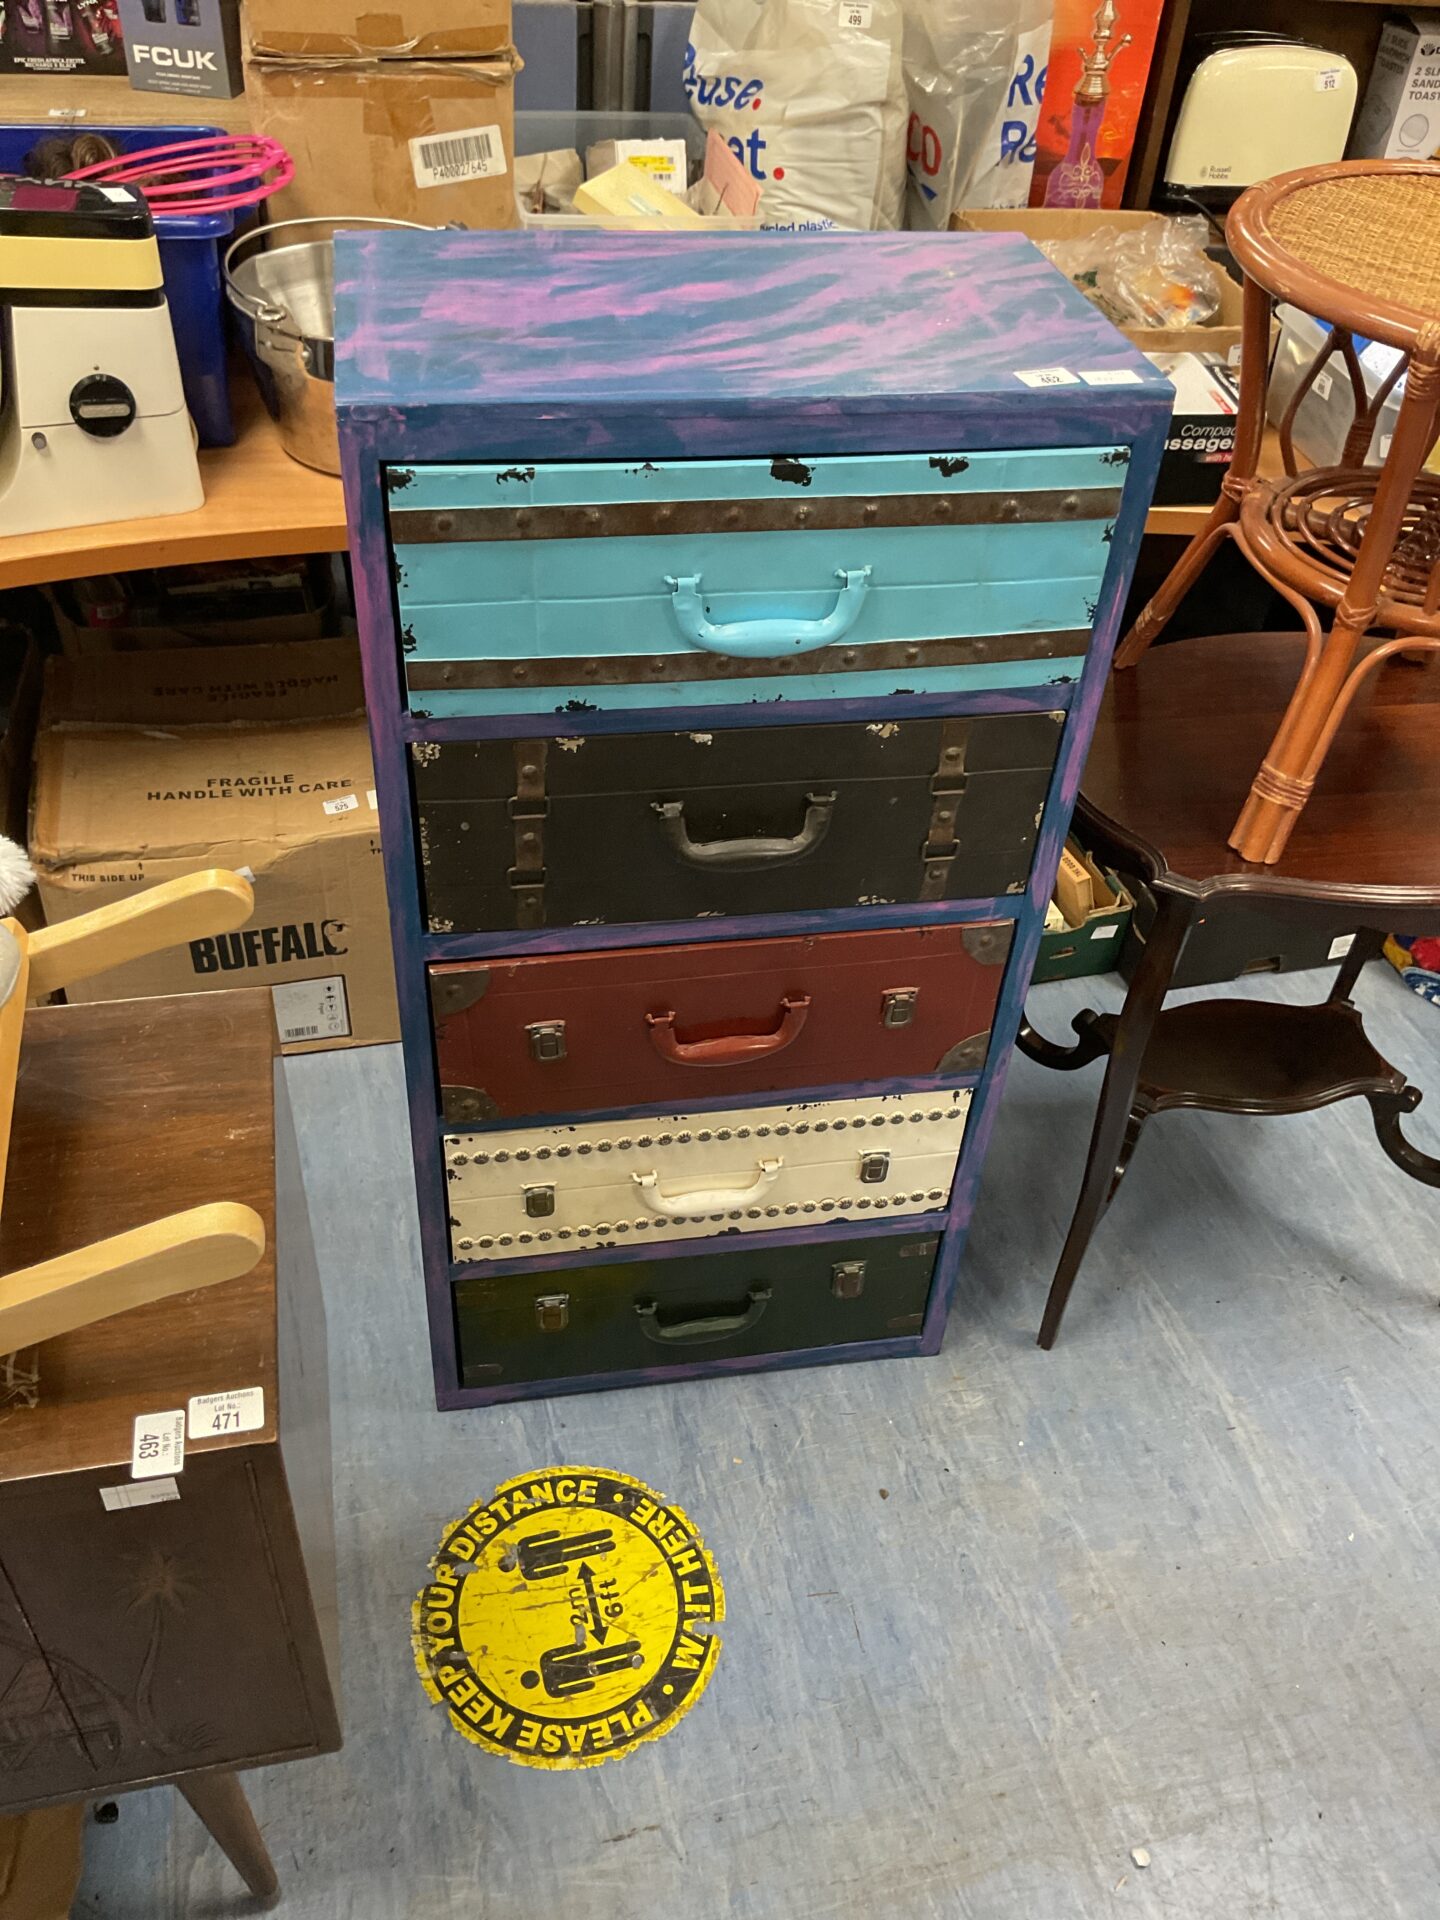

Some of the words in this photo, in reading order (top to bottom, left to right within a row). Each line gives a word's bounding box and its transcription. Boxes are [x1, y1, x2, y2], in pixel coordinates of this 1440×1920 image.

[848, 14, 862, 25] 499
[132, 44, 218, 71] FCUK
[1414, 67, 1422, 76] 2
[432, 160, 488, 181] P400027645
[147, 789, 233, 801] HANDLE
[239, 786, 292, 797] WITH
[299, 779, 352, 793] CARE
[207, 774, 295, 788] FRAGILE
[72, 873, 96, 882] THIS
[100, 874, 126, 882] SIDE
[129, 873, 145, 881] UP
[212, 1411, 240, 1431] 471
[138, 1433, 160, 1460] 463
[448, 1479, 599, 1561] DISTANCE
[629, 1498, 702, 1576] HERE
[426, 1563, 459, 1658] YOUR
[569, 1586, 589, 1628] 2m
[599, 1577, 624, 1618] 6ft
[438, 1665, 515, 1740] KEEP
[516, 1699, 654, 1753] PLEASE
